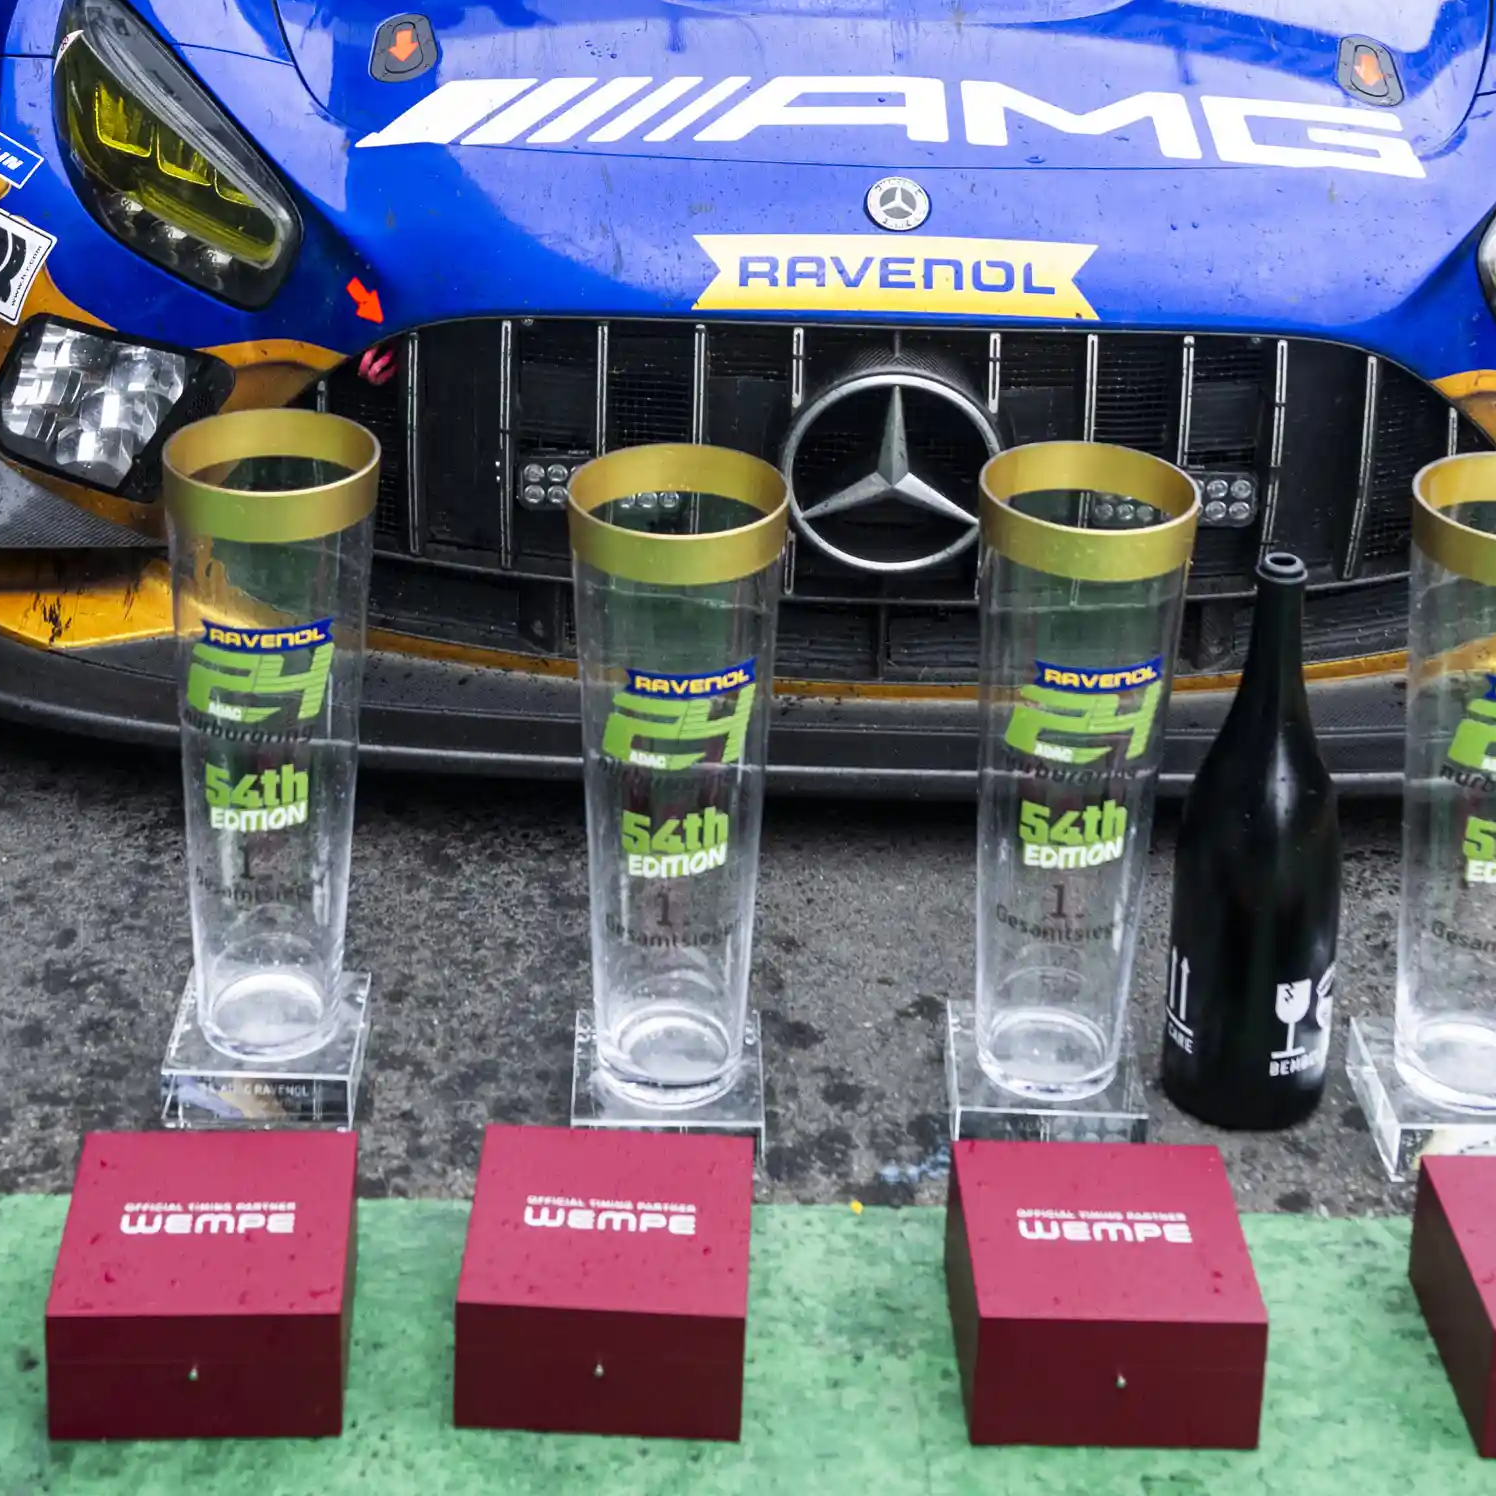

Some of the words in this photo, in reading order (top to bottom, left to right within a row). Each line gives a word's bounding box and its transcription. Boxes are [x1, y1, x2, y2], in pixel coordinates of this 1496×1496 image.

[694, 75, 1426, 179] AMG
[737, 255, 1055, 295] RAVENOL
[208, 626, 326, 649] RAVENOL
[634, 668, 750, 695] RAVENOL
[1043, 665, 1158, 690] RAVENOL
[205, 762, 309, 809] 54th
[210, 801, 308, 834] EDITION
[620, 805, 730, 854] 54th
[1018, 798, 1128, 846] 54th
[627, 842, 728, 879] EDITION
[1022, 835, 1125, 870] EDITION
[119, 1212, 296, 1235] WEMPE
[523, 1206, 697, 1236] WEMPE
[1018, 1220, 1192, 1245] WEMPE
